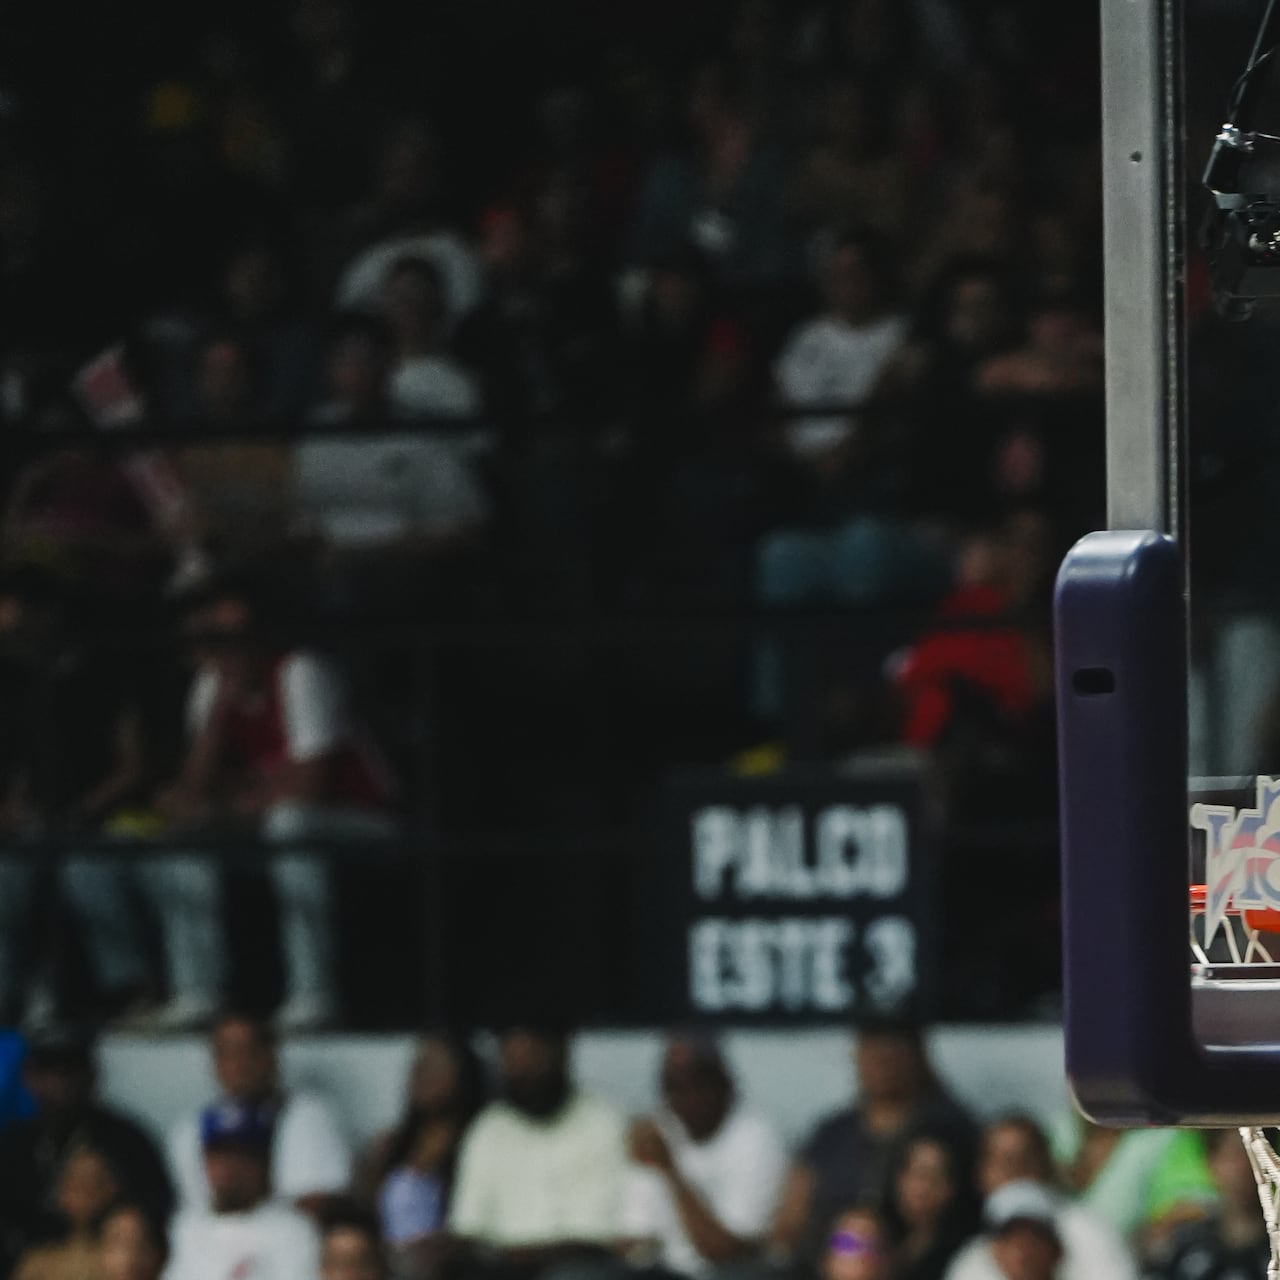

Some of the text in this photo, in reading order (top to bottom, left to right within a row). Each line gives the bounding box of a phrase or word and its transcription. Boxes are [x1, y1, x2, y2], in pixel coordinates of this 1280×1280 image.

[691, 802, 909, 900] PALCO
[689, 914, 918, 1012] ESTE 3
